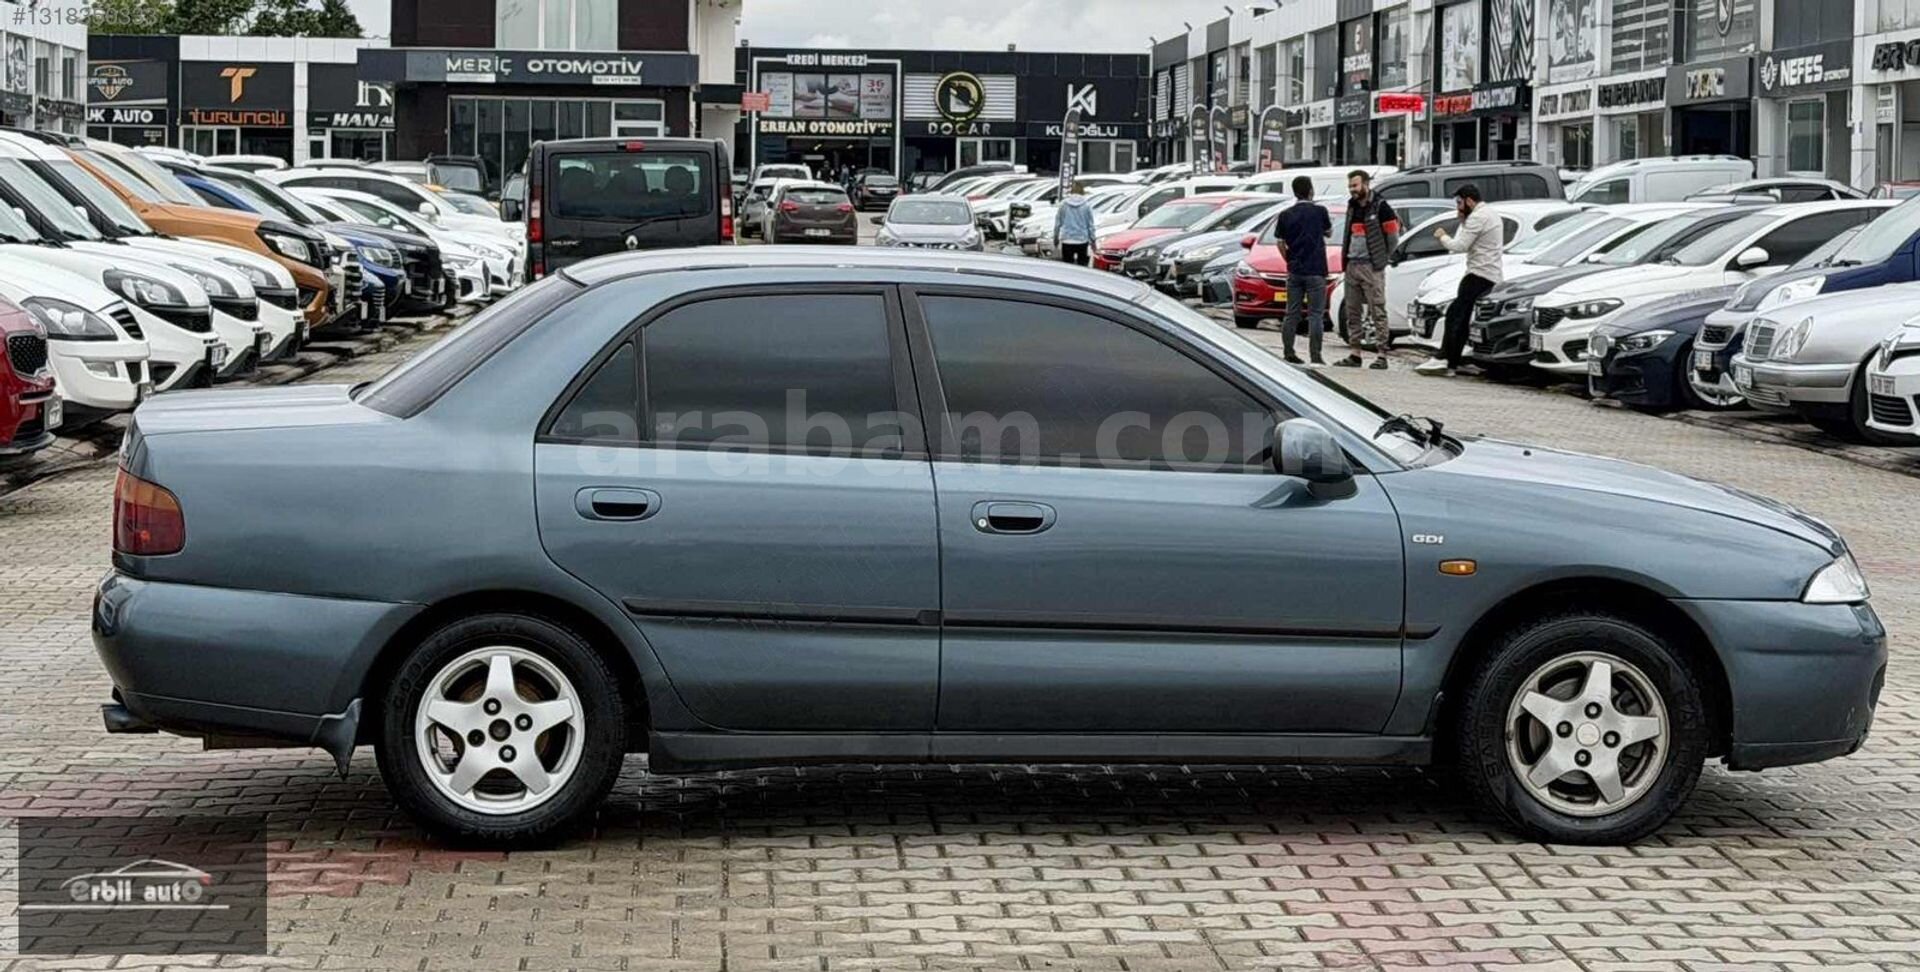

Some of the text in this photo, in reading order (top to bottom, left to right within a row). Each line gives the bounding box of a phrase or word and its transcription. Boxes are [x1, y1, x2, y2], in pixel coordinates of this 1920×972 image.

[446, 56, 643, 75] MERİÇ OTOMOTİV
[787, 54, 867, 67] KREDİ MERKEZİ
[1780, 55, 1823, 87] NEFES
[112, 109, 154, 123] AUTO
[760, 121, 806, 133] ERHAN
[809, 119, 876, 134] OTOMOTİV
[928, 122, 991, 135] DOCAR
[1046, 123, 1118, 137] KUOĞLU
